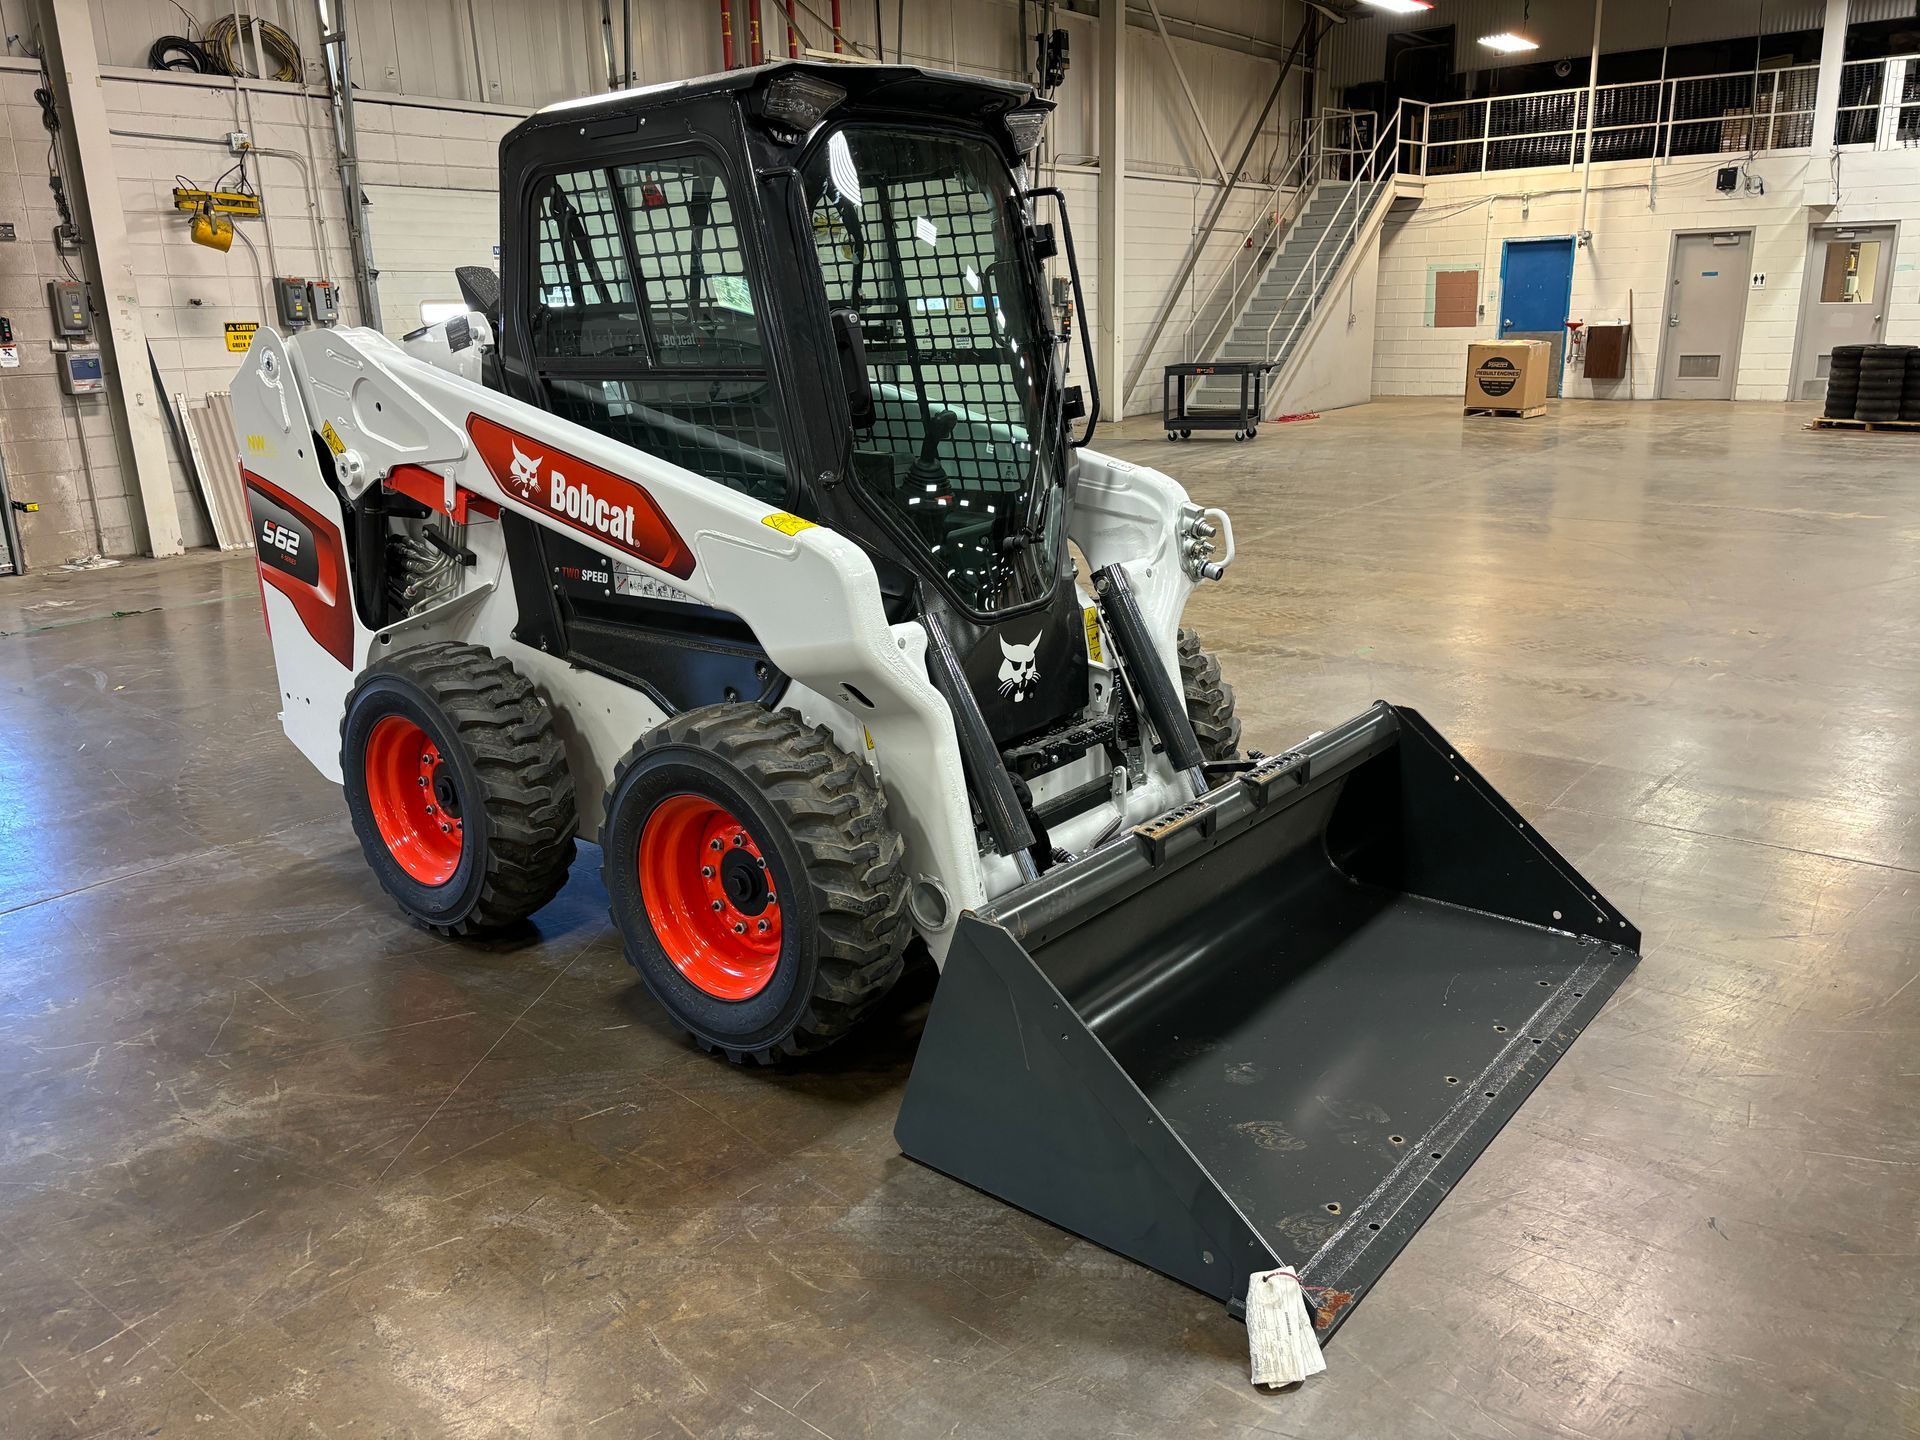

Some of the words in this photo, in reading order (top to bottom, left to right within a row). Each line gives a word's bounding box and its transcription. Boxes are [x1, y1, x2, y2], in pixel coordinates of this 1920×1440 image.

[550, 469, 635, 546] Bobcat
[262, 520, 300, 556] S62
[562, 566, 580, 580] TWO
[581, 569, 609, 584] SPEED
